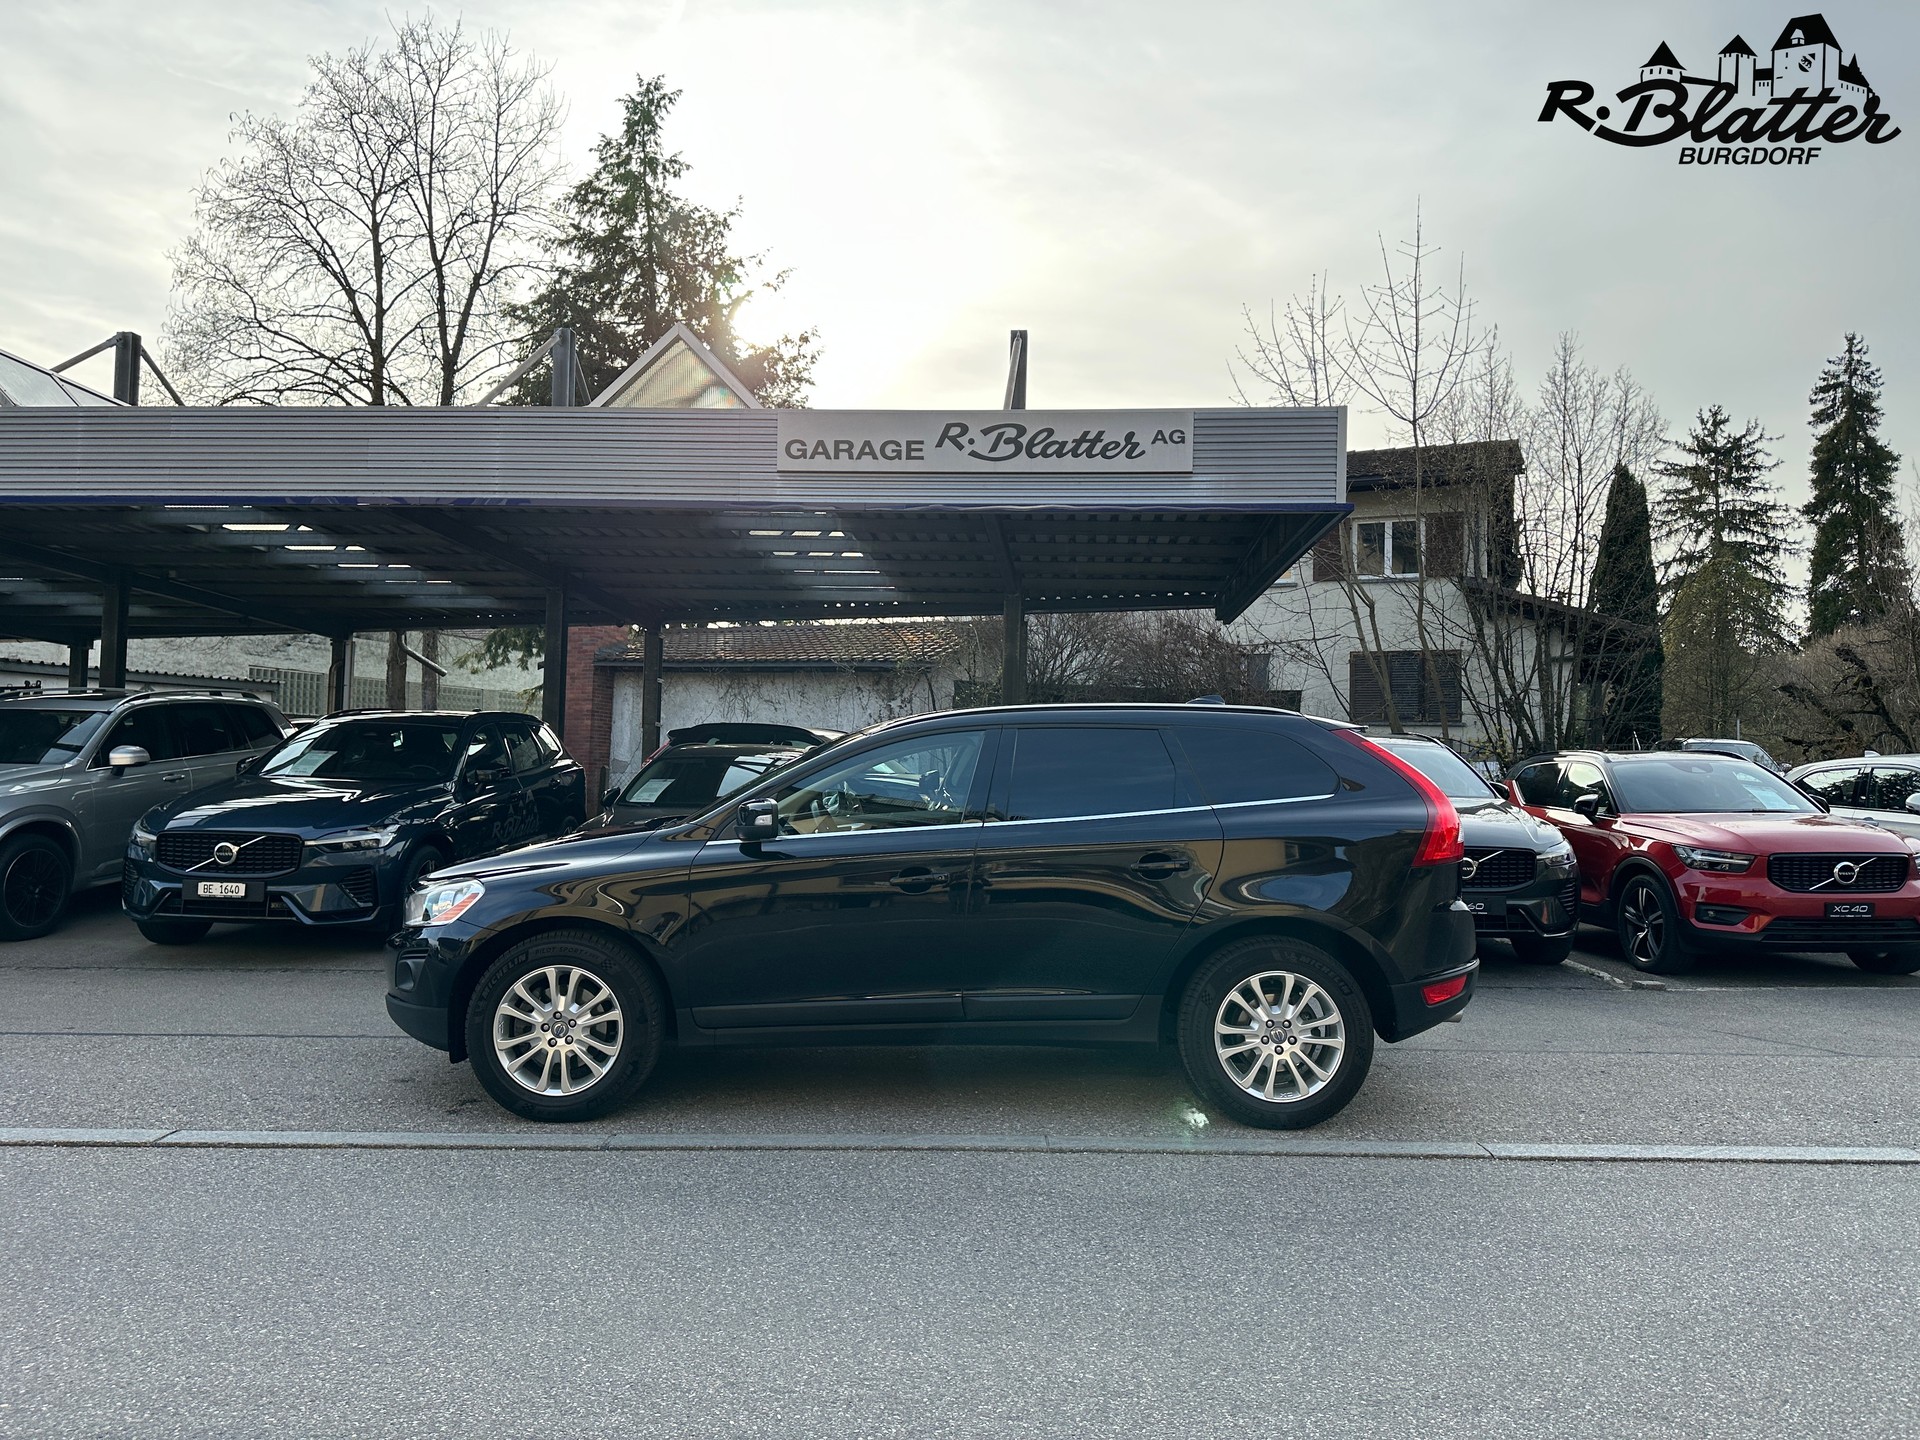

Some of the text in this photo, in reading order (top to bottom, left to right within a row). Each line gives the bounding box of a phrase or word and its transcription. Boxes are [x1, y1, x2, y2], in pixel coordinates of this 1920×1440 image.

[784, 439, 925, 461] GARAGE
[1151, 429, 1186, 446] AG
[203, 884, 240, 894] BE 1640
[535, 946, 583, 955] PILOT SPORT
[481, 952, 528, 998] MICHELIN
[1299, 955, 1352, 996] MICHELIN
